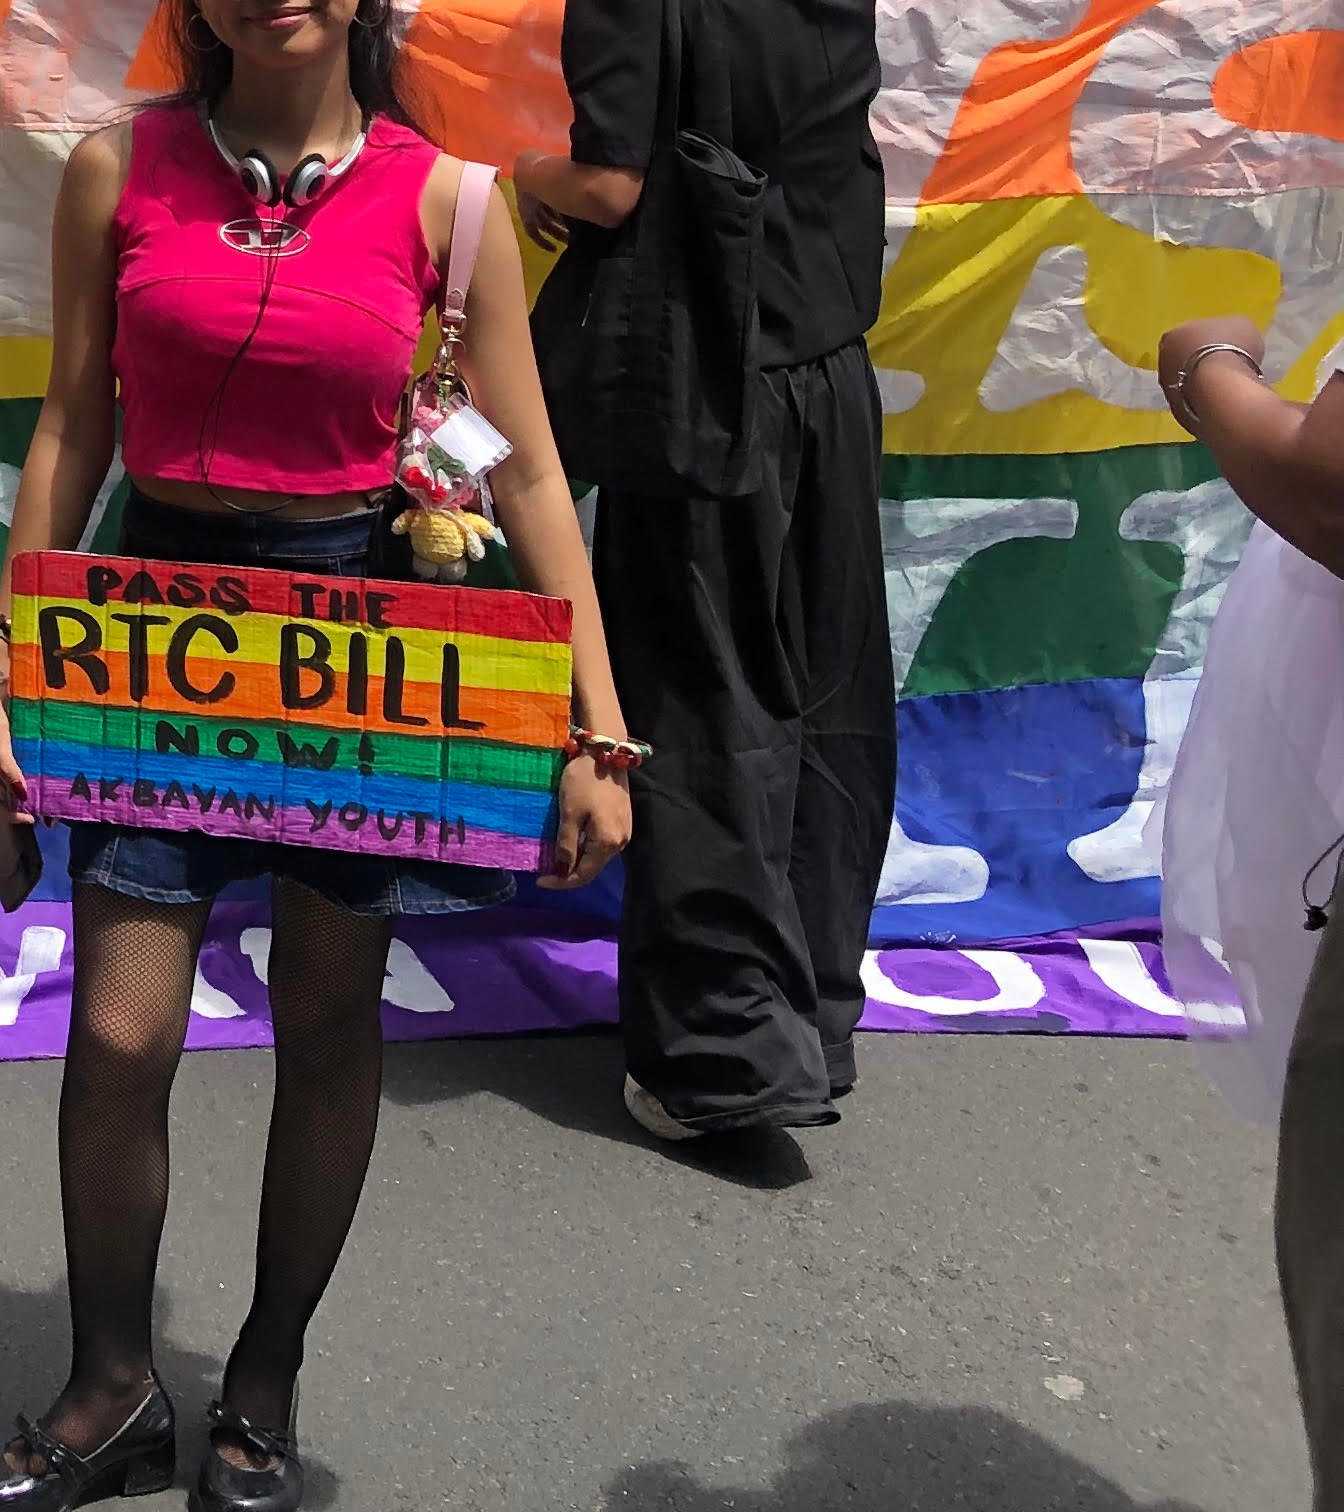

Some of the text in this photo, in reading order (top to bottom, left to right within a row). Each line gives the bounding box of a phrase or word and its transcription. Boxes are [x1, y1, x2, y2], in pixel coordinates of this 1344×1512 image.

[86, 565, 398, 629] PASS THE
[38, 605, 486, 732] RTC BILL
[155, 719, 375, 776] NOW!
[68, 772, 466, 845] AKBAYAN YOUTH
